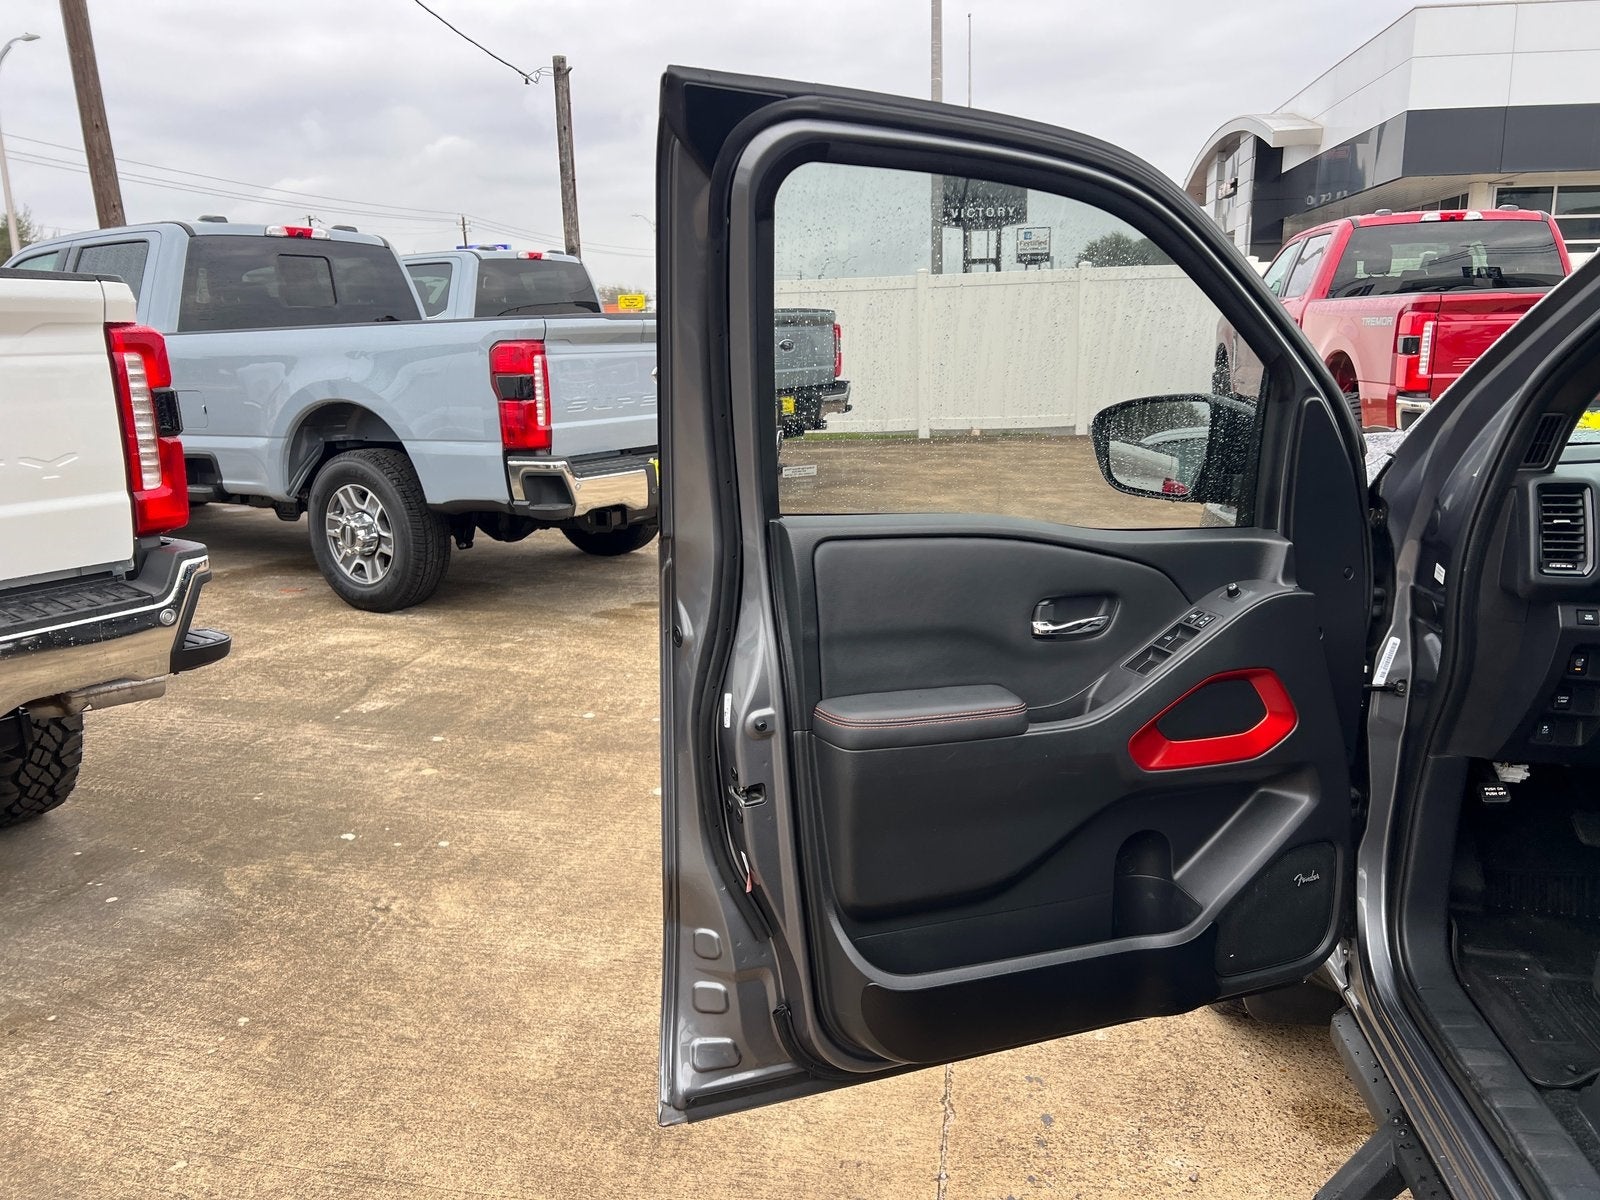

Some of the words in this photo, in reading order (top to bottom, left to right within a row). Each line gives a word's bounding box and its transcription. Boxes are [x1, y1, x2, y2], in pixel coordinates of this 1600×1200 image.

[950, 206, 1016, 219] VICTORY
[1361, 316, 1394, 326] TREMOR
[1293, 869, 1320, 887] Fender
